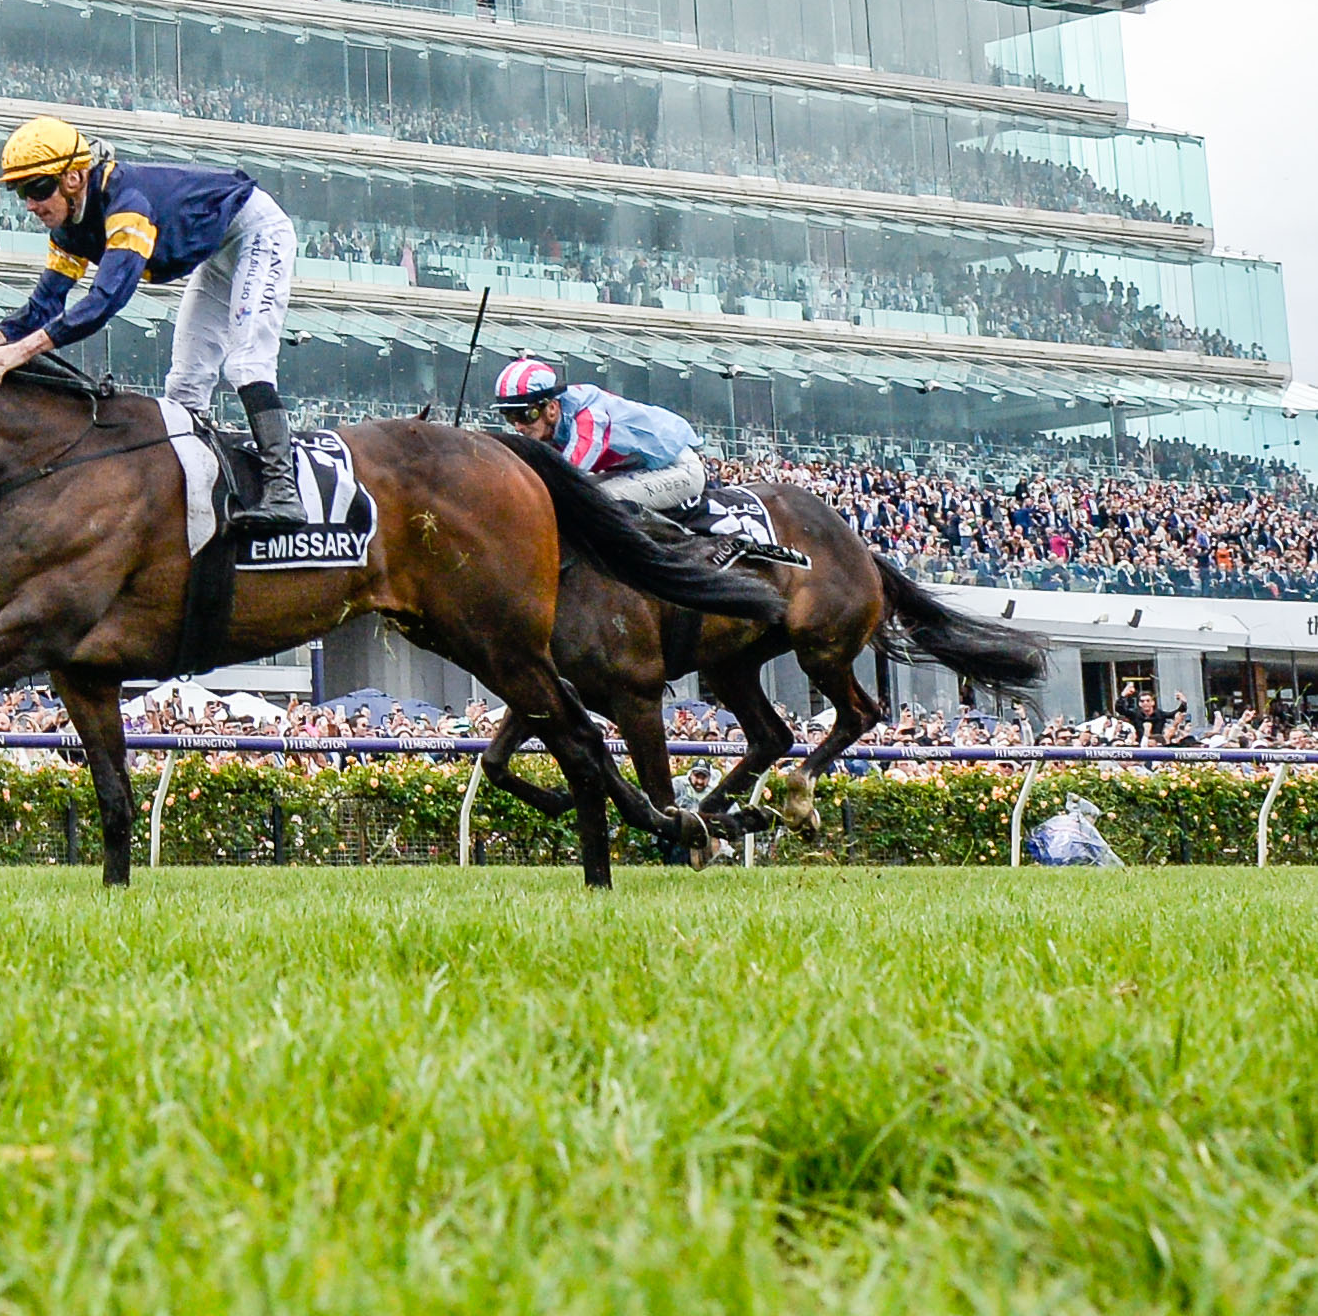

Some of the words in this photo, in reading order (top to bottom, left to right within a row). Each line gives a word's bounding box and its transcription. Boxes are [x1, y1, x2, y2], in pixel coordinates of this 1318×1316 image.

[241, 280, 253, 300] OFF
[251, 532, 367, 560] EMISSARY
[177, 737, 237, 748] FLEMINGTON
[289, 738, 348, 749] FLEMINGTON
[398, 739, 455, 750] FLEMINGTON
